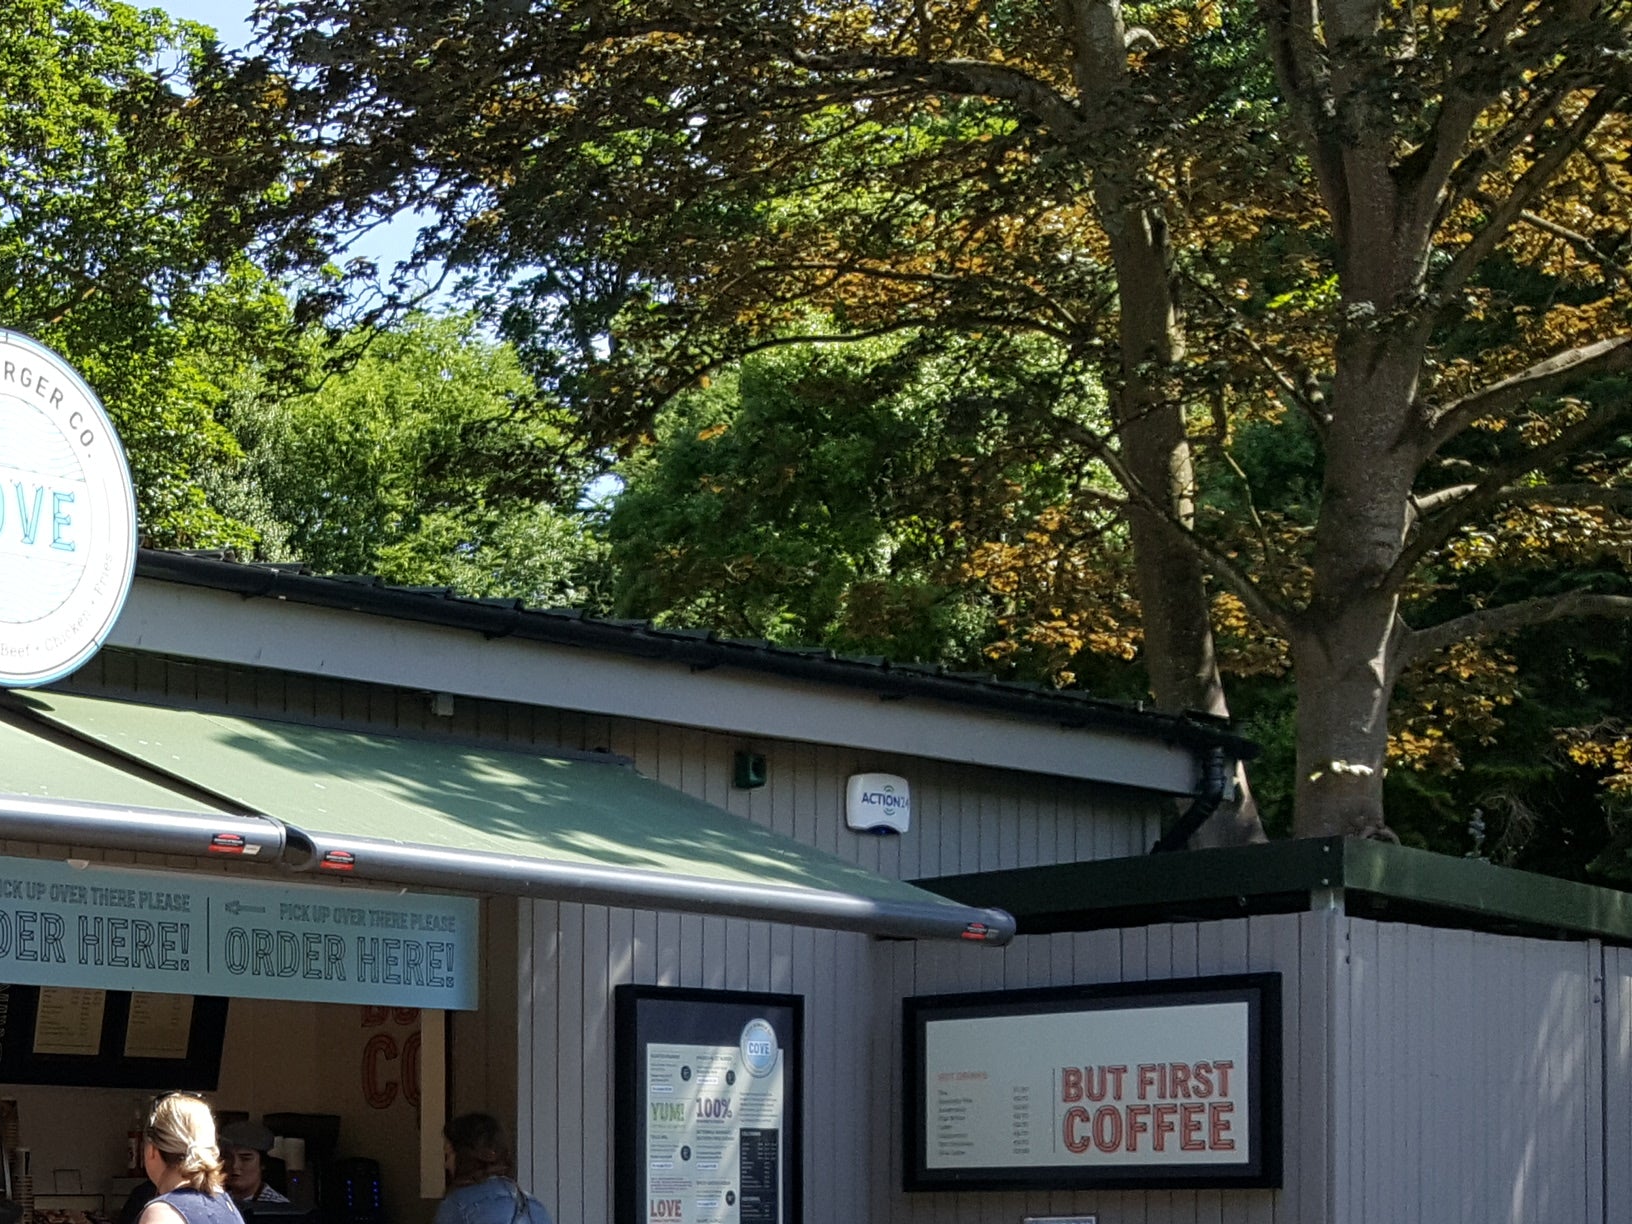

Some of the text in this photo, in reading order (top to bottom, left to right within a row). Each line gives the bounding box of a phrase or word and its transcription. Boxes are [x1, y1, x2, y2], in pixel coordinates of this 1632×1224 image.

[0, 641, 33, 658] Beef
[93, 552, 114, 597] Fries
[26, 882, 48, 902] UP
[49, 883, 89, 906] OVER
[91, 887, 137, 909] THERE
[138, 891, 192, 913] PLEASE
[279, 902, 457, 934] PICK UP OVER THERE PLEASE
[77, 913, 191, 972] HERE!
[224, 925, 456, 989] ORDER HERE!
[748, 1042, 770, 1055] COVE
[1061, 1059, 1235, 1103] BUT FIRST
[650, 1101, 685, 1122] YUM!
[696, 1097, 733, 1120] 100%
[1062, 1101, 1236, 1155] COFFEE
[650, 1198, 683, 1218] LOVE
